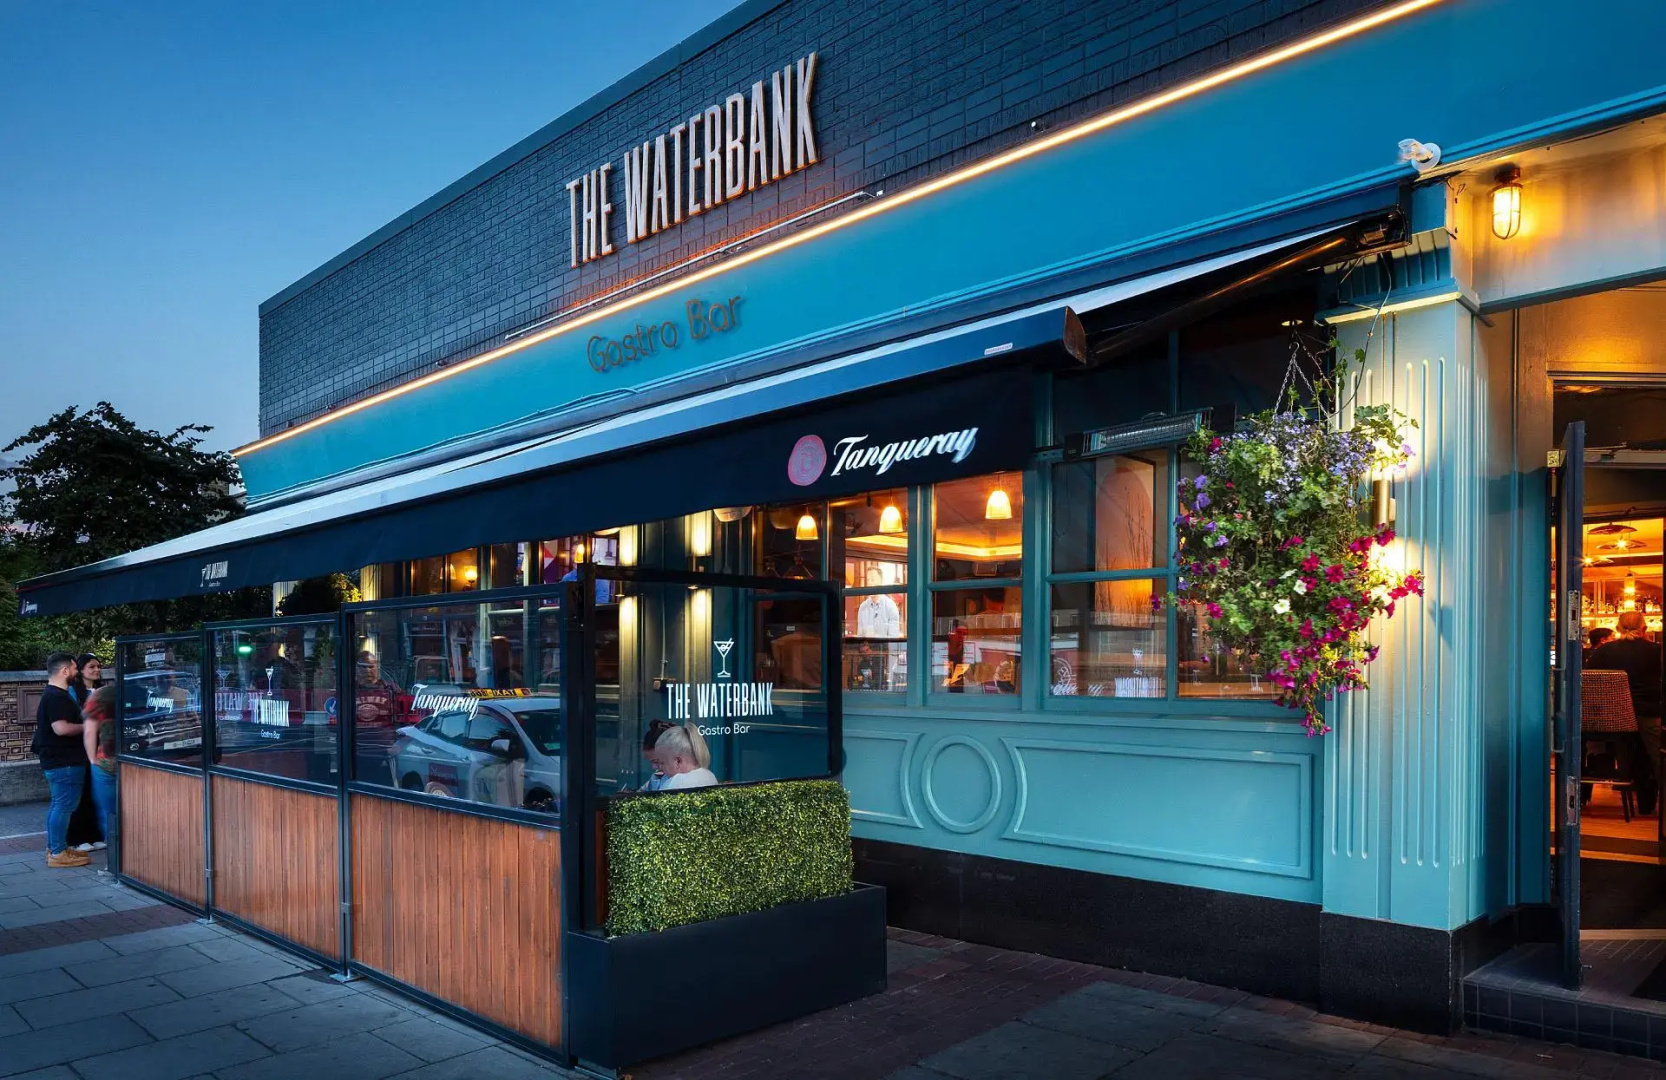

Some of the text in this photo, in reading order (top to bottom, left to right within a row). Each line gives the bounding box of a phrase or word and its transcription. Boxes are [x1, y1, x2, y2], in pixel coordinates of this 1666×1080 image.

[565, 51, 819, 269] THE WATERBANK
[586, 295, 741, 373] Gastro Bar
[830, 427, 979, 477] Tanqueray
[411, 683, 480, 720] Tanqueray
[666, 682, 773, 719] THE WATERBANK
[697, 723, 750, 736] Gastro Bar
